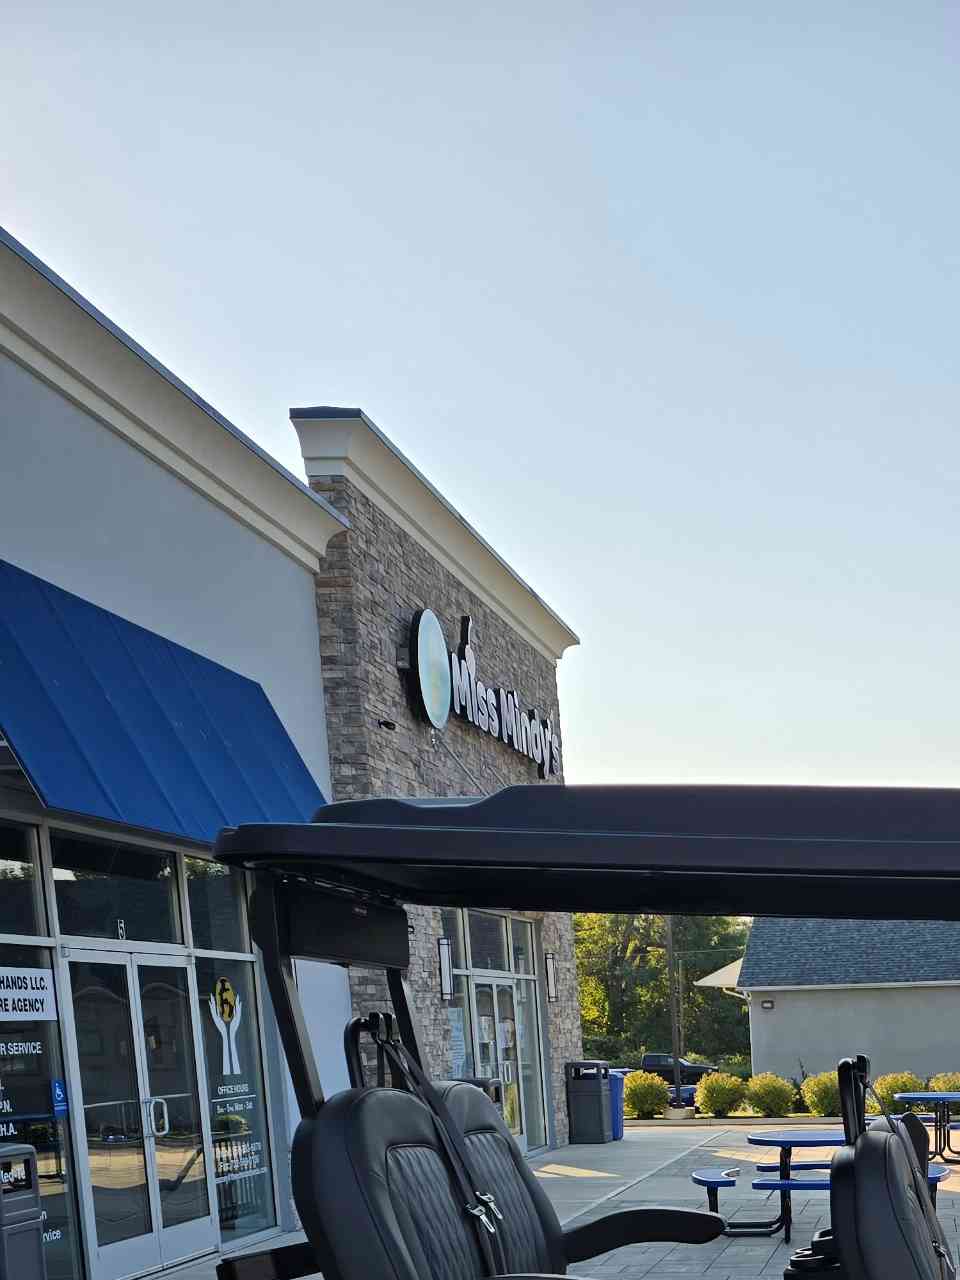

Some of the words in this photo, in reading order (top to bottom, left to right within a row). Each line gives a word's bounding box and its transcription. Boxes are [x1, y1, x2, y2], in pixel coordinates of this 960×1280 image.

[451, 616, 498, 738] Miss
[499, 687, 561, 780] Mindy's
[0, 975, 28, 991] HANDS
[12, 998, 45, 1012] AGENCY
[7, 1041, 42, 1055] SERVICE
[42, 1228, 61, 1242] rvice
